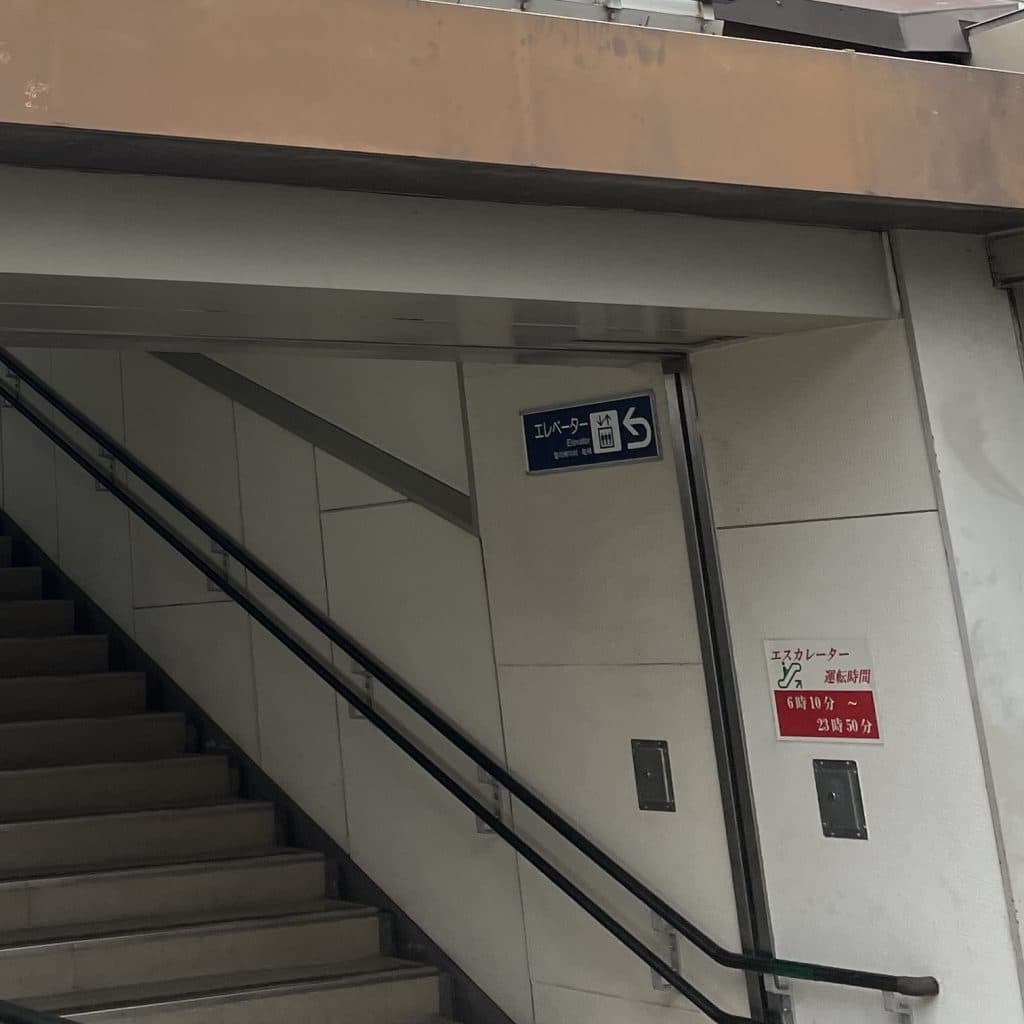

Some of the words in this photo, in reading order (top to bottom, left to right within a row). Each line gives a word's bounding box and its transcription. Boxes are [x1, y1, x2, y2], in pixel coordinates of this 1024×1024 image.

[534, 417, 589, 438] エレベーター
[771, 647, 850, 662] エスカレーター
[824, 669, 871, 684] 運転時間
[816, 717, 872, 734] 23時50分
